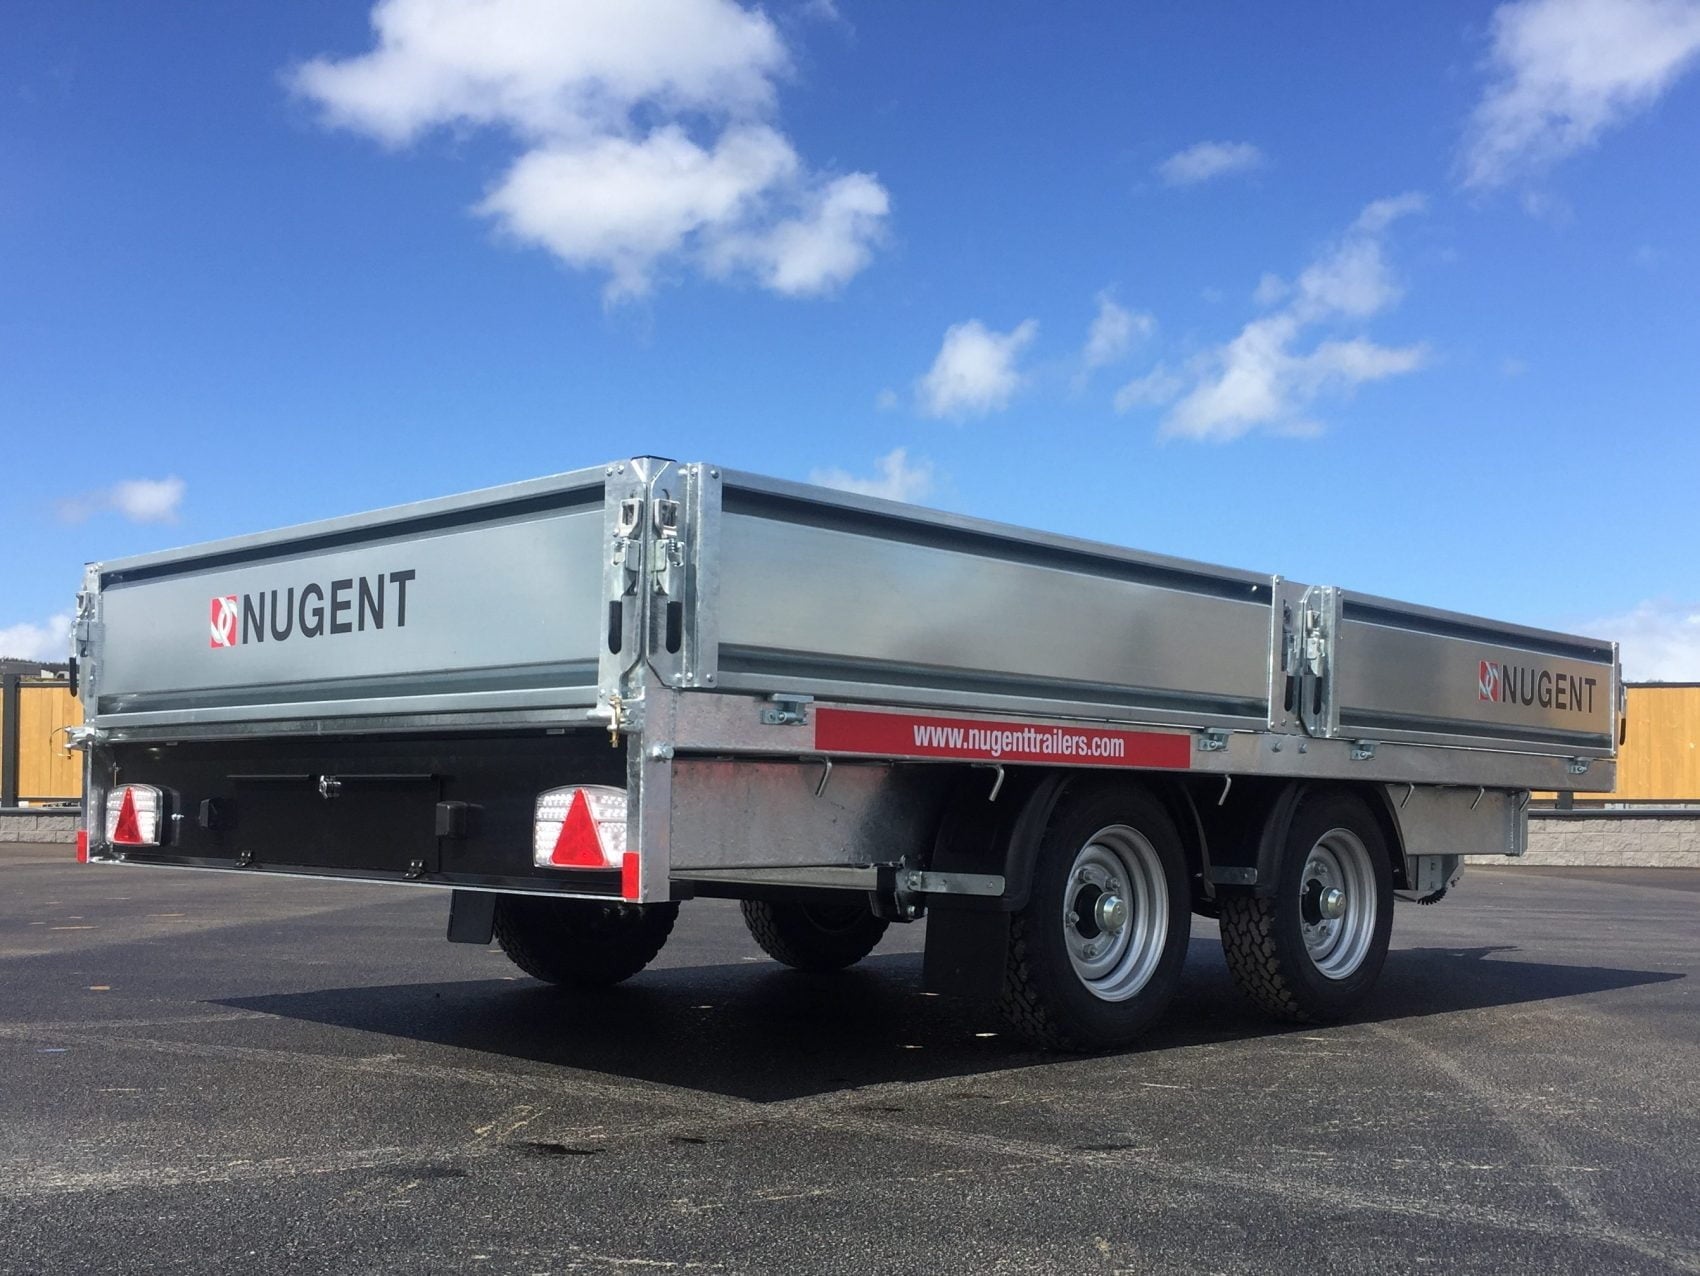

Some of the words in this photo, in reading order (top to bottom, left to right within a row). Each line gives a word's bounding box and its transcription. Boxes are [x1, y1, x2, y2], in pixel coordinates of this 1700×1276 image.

[242, 569, 416, 644] NUGENT
[1502, 664, 1597, 713] NUGENT
[913, 725, 1125, 758] www.nugenttrailers.com
